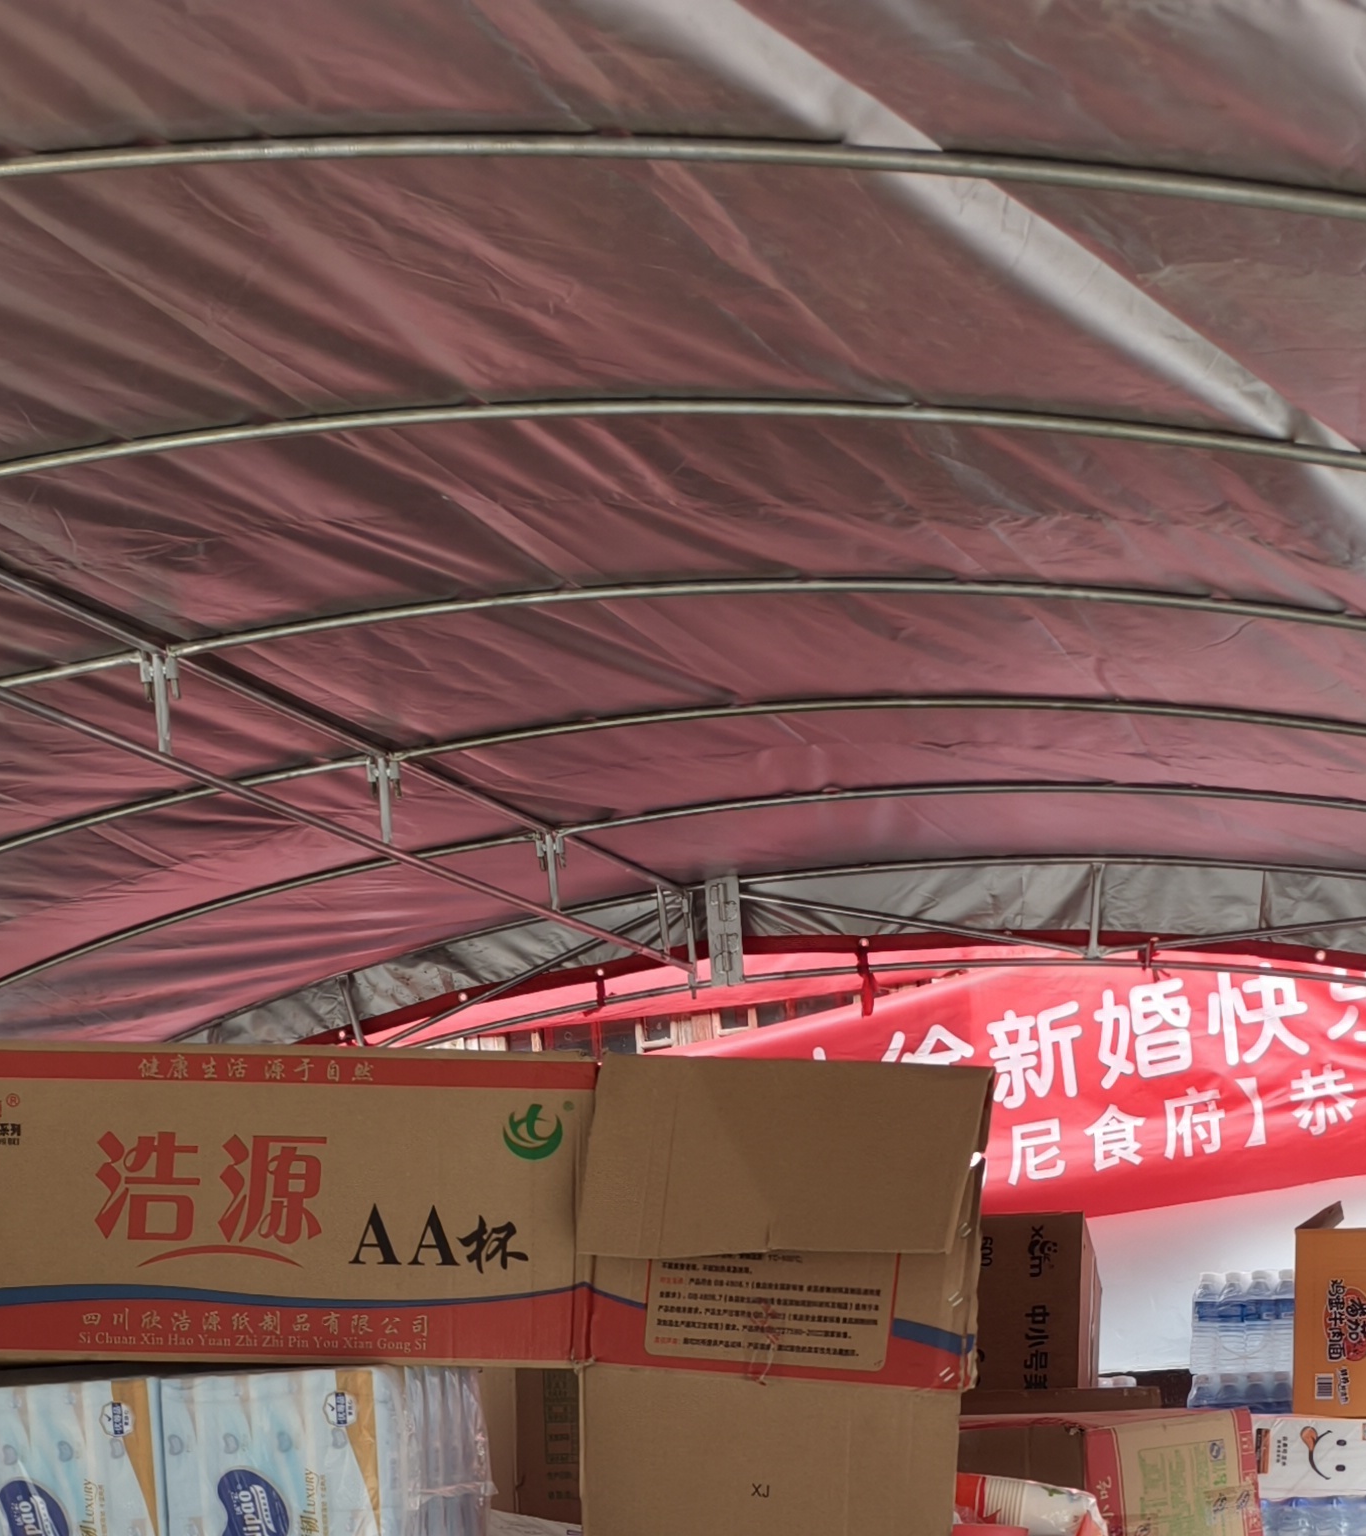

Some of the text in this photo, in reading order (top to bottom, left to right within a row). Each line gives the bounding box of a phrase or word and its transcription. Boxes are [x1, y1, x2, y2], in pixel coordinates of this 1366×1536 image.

[138, 1056, 374, 1083] 健康生活 源于自然
[94, 1130, 328, 1245] 浩源
[348, 1203, 529, 1275] AA杯
[81, 1308, 430, 1338] 四川欣浩源纸制品有限公司
[1327, 1278, 1347, 1362] 鸡蛋牛肉面
[78, 1333, 427, 1354] Si Chuan Xin Hao Yuan Zhi Zhi Pin You Xian Gong Si
[84, 1478, 98, 1523] LUXURY
[303, 1468, 318, 1514] LUXURY
[751, 1483, 770, 1498] XJ
